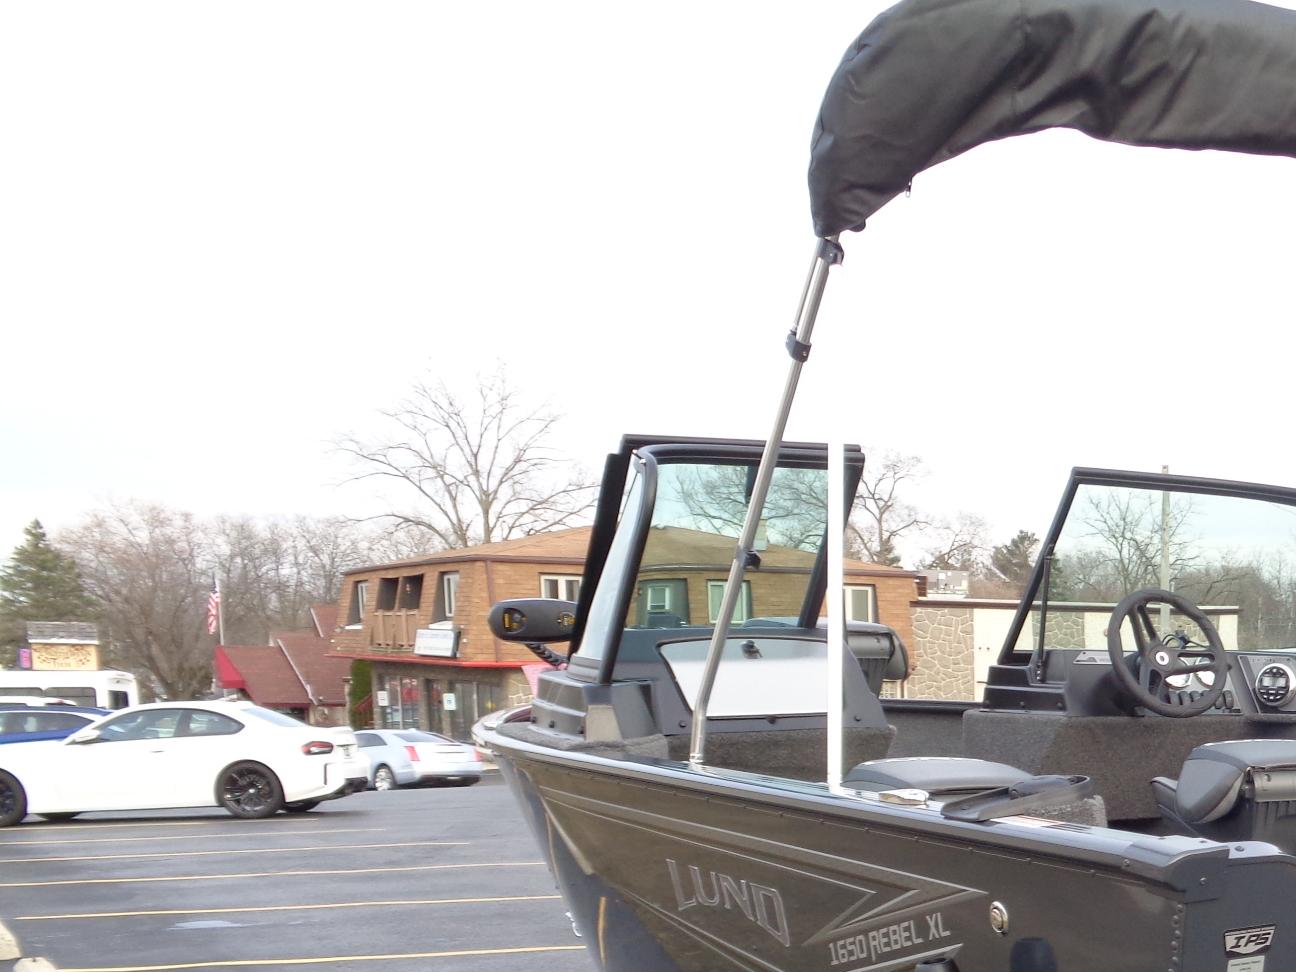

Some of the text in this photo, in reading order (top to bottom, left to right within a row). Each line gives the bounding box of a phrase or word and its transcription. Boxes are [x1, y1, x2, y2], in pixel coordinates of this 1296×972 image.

[665, 858, 790, 948] LUND
[828, 911, 951, 966] 1650 REBEL XL
[1229, 931, 1272, 950] IPS
